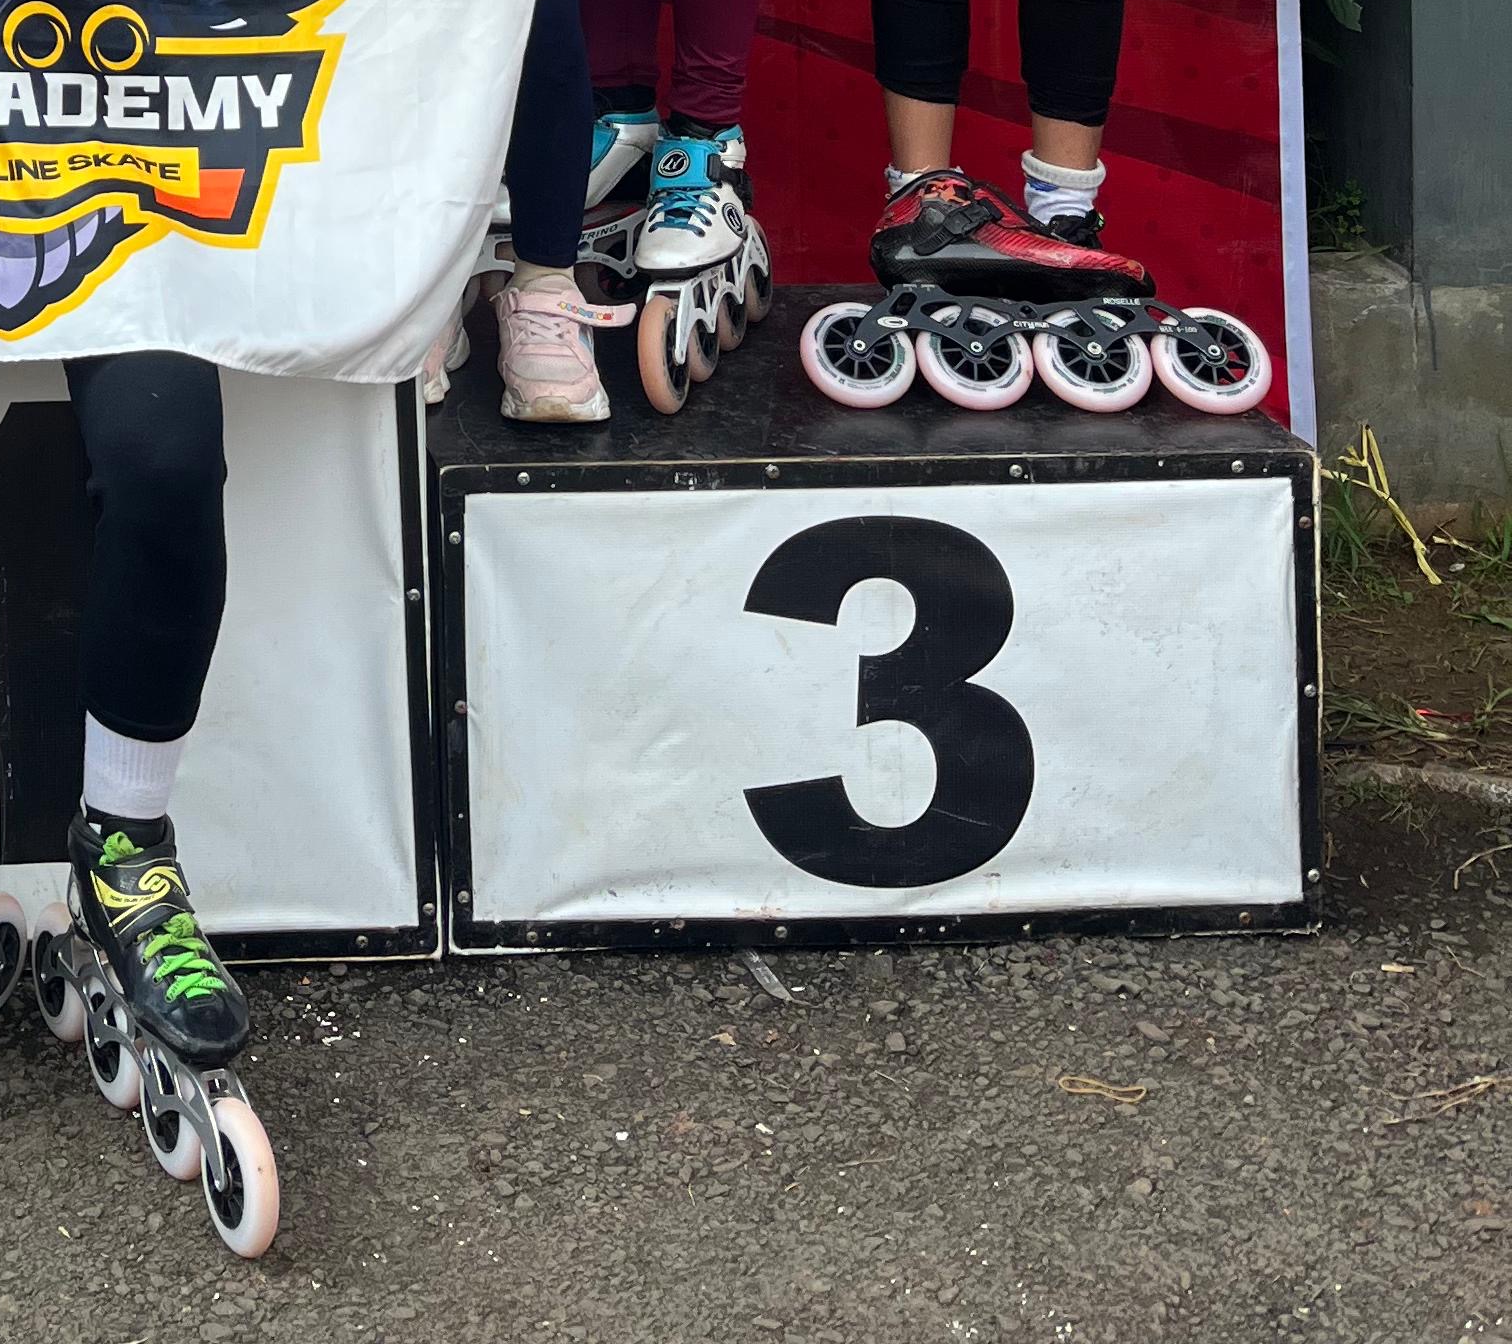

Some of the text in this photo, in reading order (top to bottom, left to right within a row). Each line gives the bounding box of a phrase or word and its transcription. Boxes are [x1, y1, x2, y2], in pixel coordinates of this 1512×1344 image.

[66, 153, 181, 183] SKATE
[1102, 297, 1141, 306] ROSELLE
[742, 514, 1036, 890] 3
